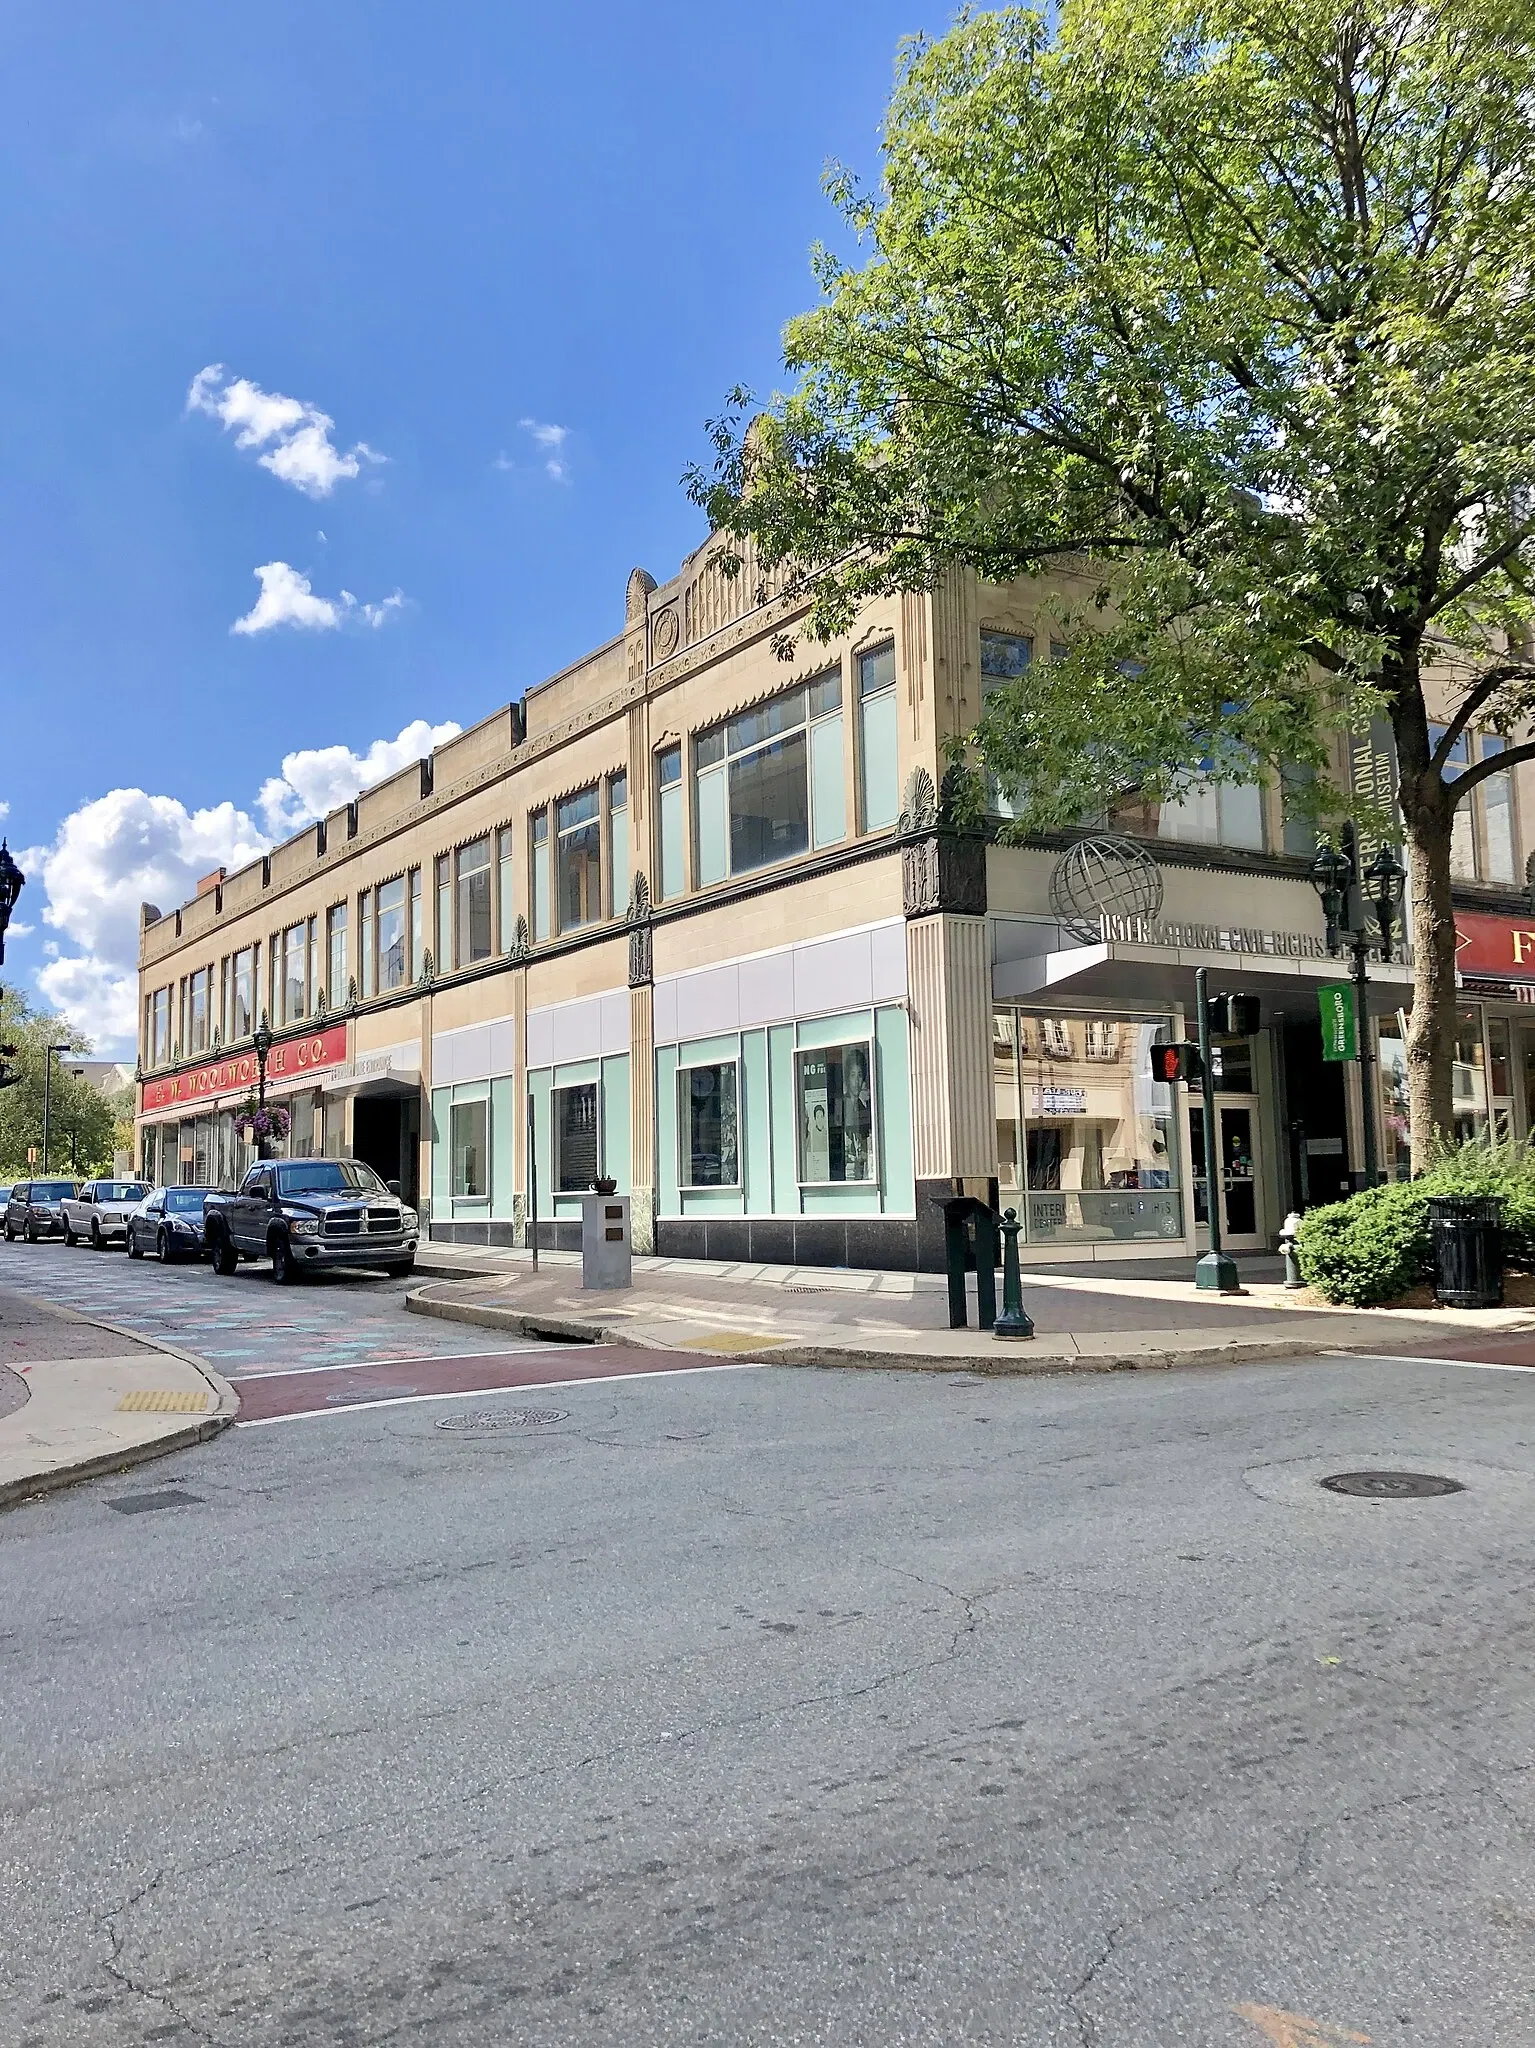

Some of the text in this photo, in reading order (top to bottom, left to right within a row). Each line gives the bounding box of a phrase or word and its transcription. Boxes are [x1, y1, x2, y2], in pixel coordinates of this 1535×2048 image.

[1374, 752, 1393, 816] MUSEUM
[1099, 913, 1226, 950] INTERNATIONAL
[1229, 926, 1270, 955] CIVIL
[1271, 931, 1325, 958] RIGHTS
[1511, 930, 1535, 964] F
[1334, 992, 1345, 1052] GREENSBORO
[171, 1080, 182, 1099] W.
[297, 1039, 328, 1067] CO.
